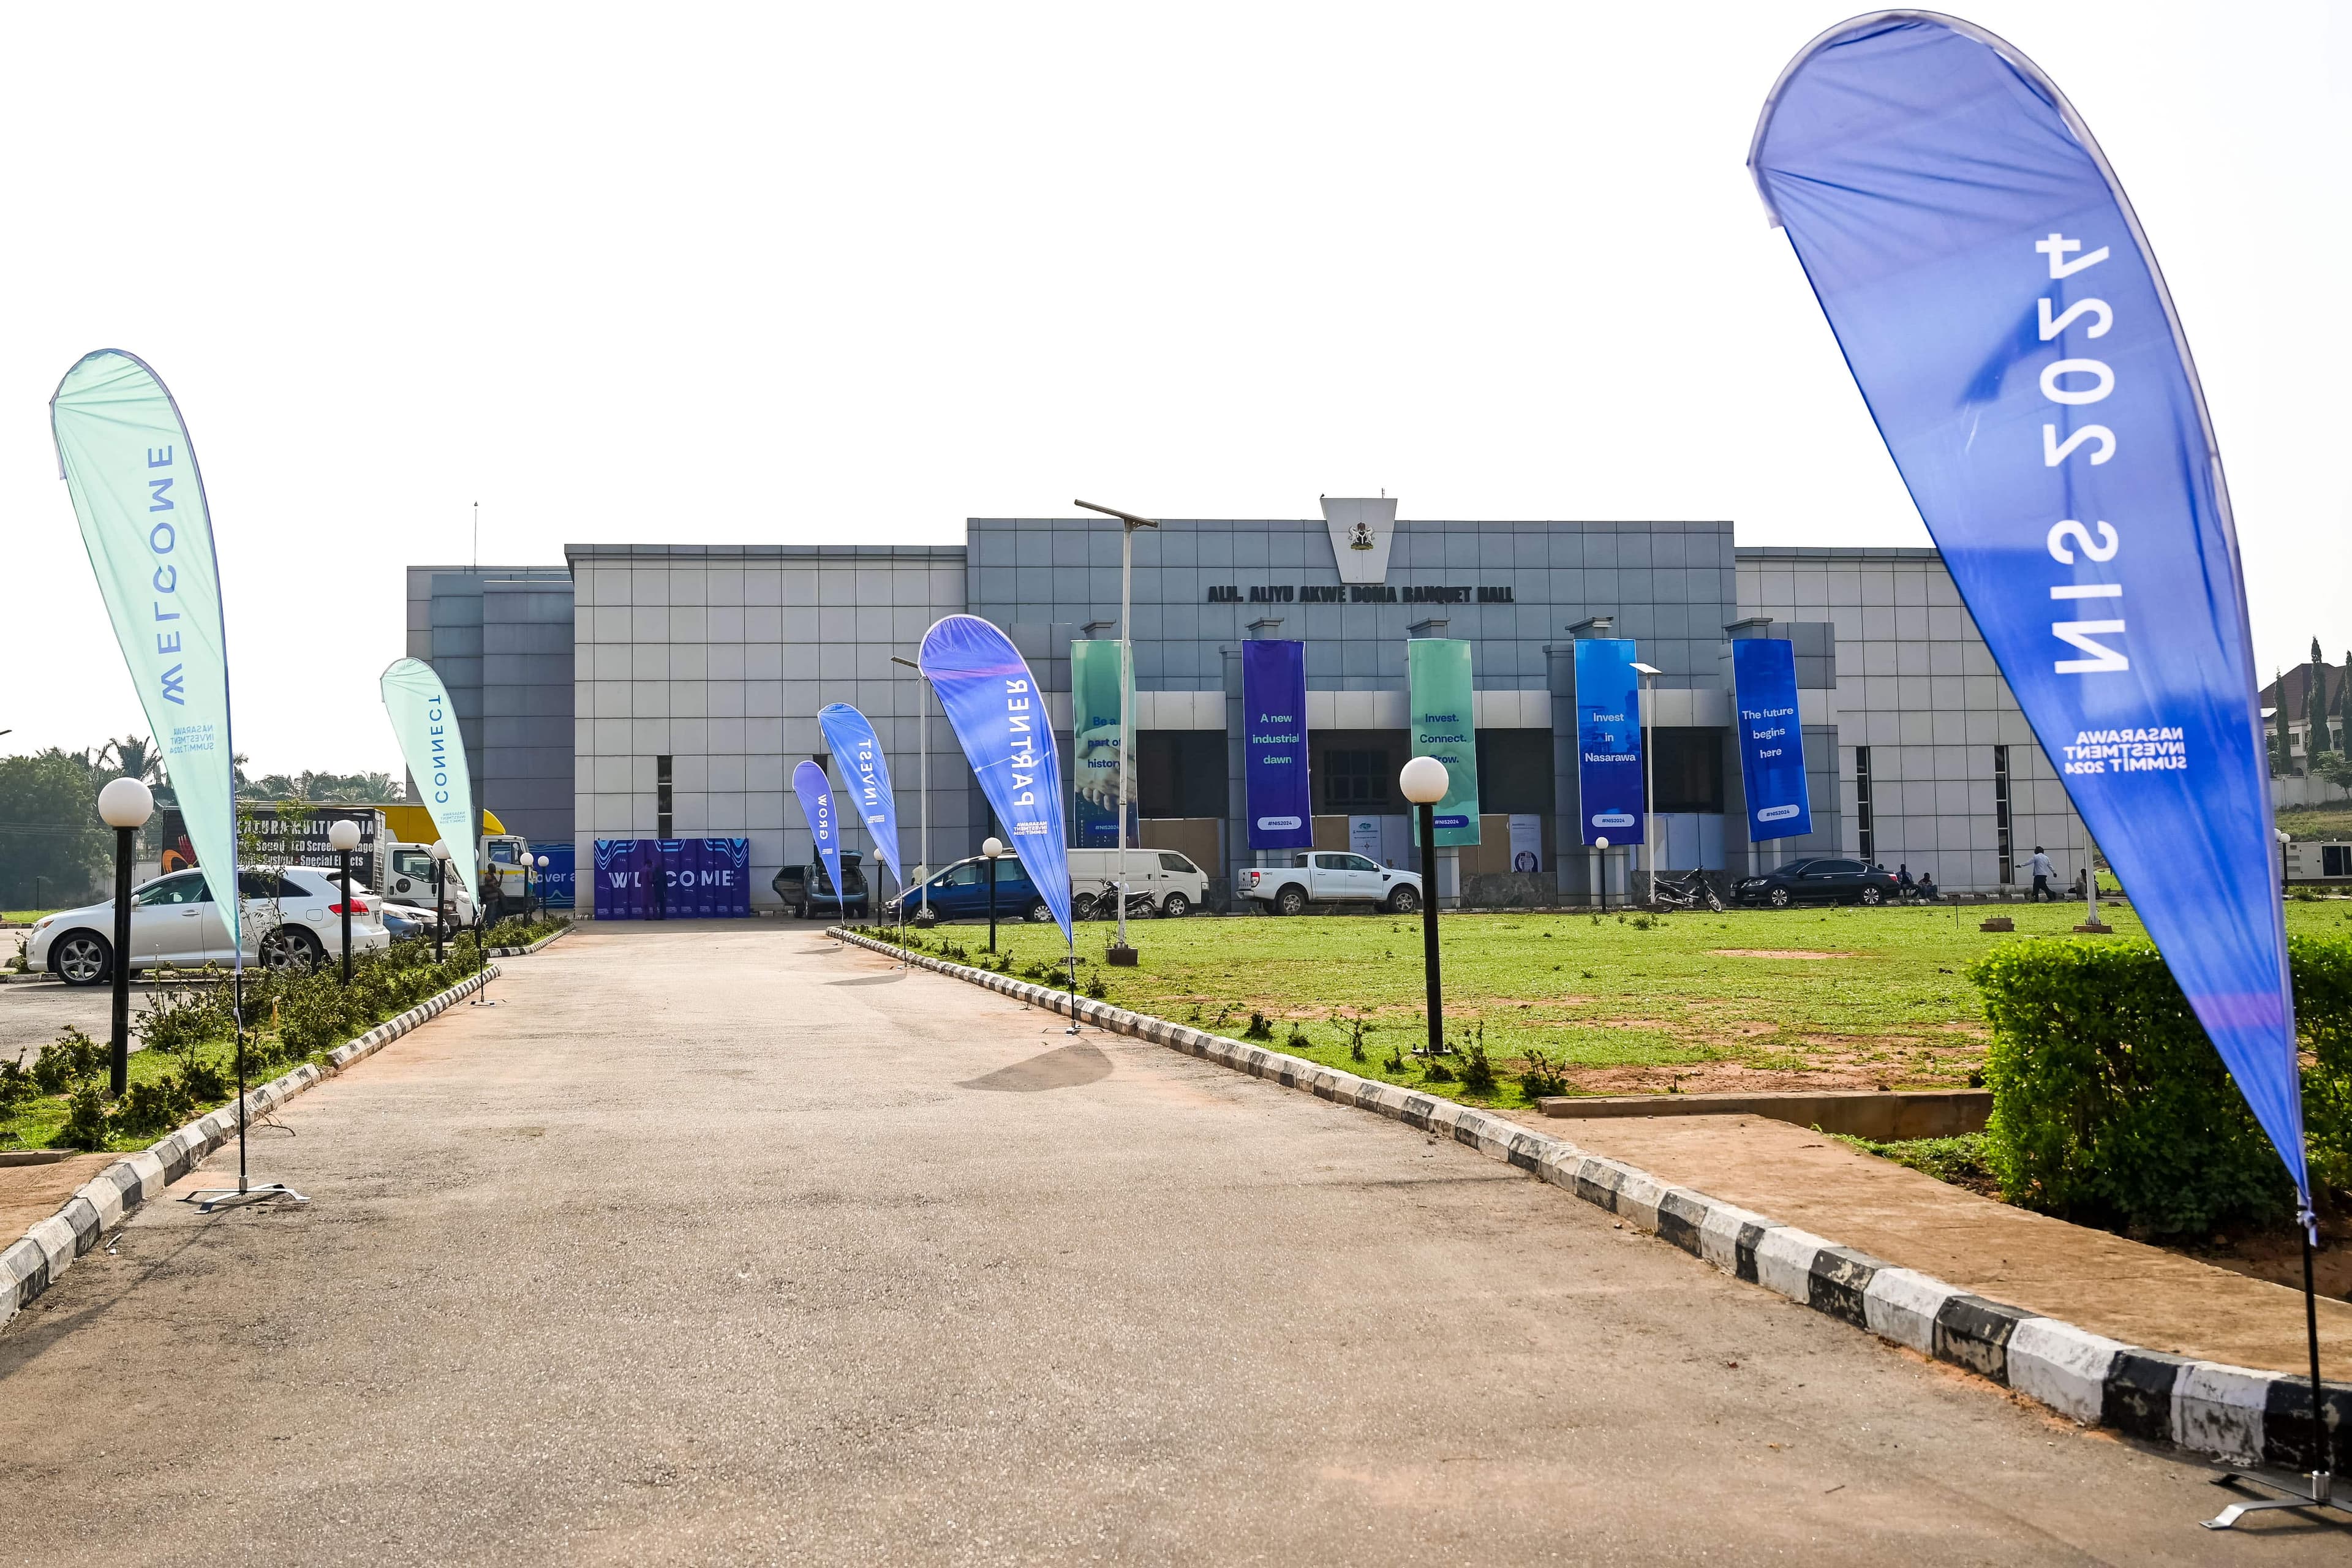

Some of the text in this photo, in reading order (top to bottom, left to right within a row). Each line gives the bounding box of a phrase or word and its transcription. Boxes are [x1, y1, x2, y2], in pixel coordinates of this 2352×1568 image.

[1250, 586, 1294, 603] ALIYU
[1300, 586, 1346, 603] AKWE
[1351, 586, 1397, 603] DOMA
[1402, 586, 1472, 604] BANQUET
[1477, 586, 1514, 603] HALL
[1260, 713, 1268, 723] A
[1425, 714, 1459, 722] Invest.
[1593, 712, 1624, 722] Invest
[1742, 708, 1794, 720] The future
[1093, 716, 1107, 726] Be
[1253, 733, 1299, 744] industrial
[1420, 734, 1466, 744] Connect.
[1605, 732, 1614, 742] in
[1753, 728, 1785, 740] begins
[1088, 738, 1109, 750] part
[1585, 752, 1636, 762] Nasarawa
[1760, 748, 1782, 759] here
[1263, 755, 1292, 764] dawn
[350, 842, 373, 853] tage
[300, 854, 332, 867] Special
